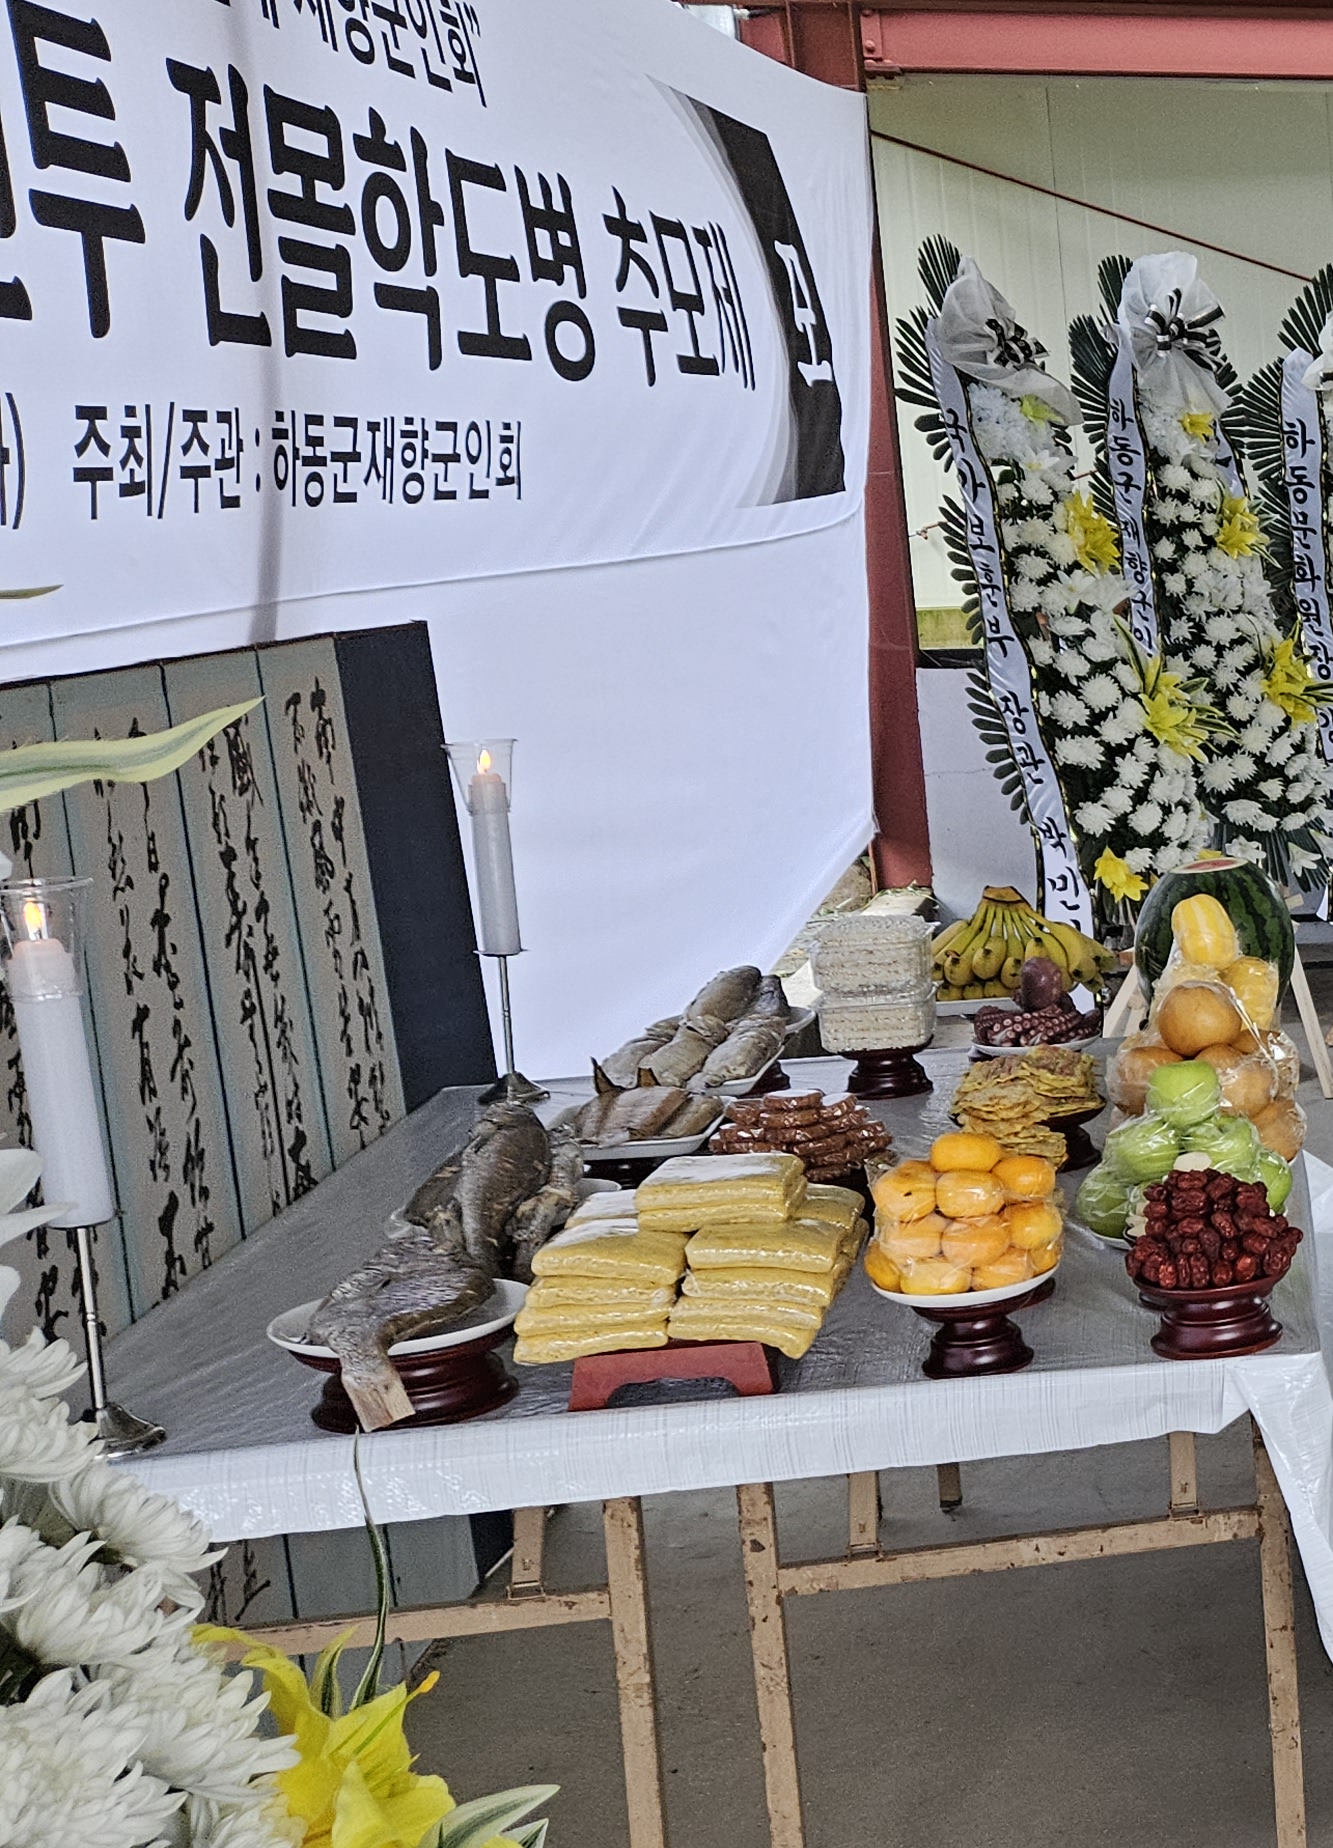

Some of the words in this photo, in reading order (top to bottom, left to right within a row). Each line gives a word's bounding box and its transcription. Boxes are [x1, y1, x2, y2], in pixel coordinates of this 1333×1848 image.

[166, 57, 596, 382] 전몰학도병
[603, 185, 756, 390] 추모제
[73, 401, 244, 520] 주최/주관
[271, 409, 523, 508] 하동군재향군인회
[1111, 397, 1142, 505] 하동군
[946, 407, 1016, 660] 국가보훈부
[999, 689, 1046, 785] 장관
[1037, 815, 1082, 932] 박민
